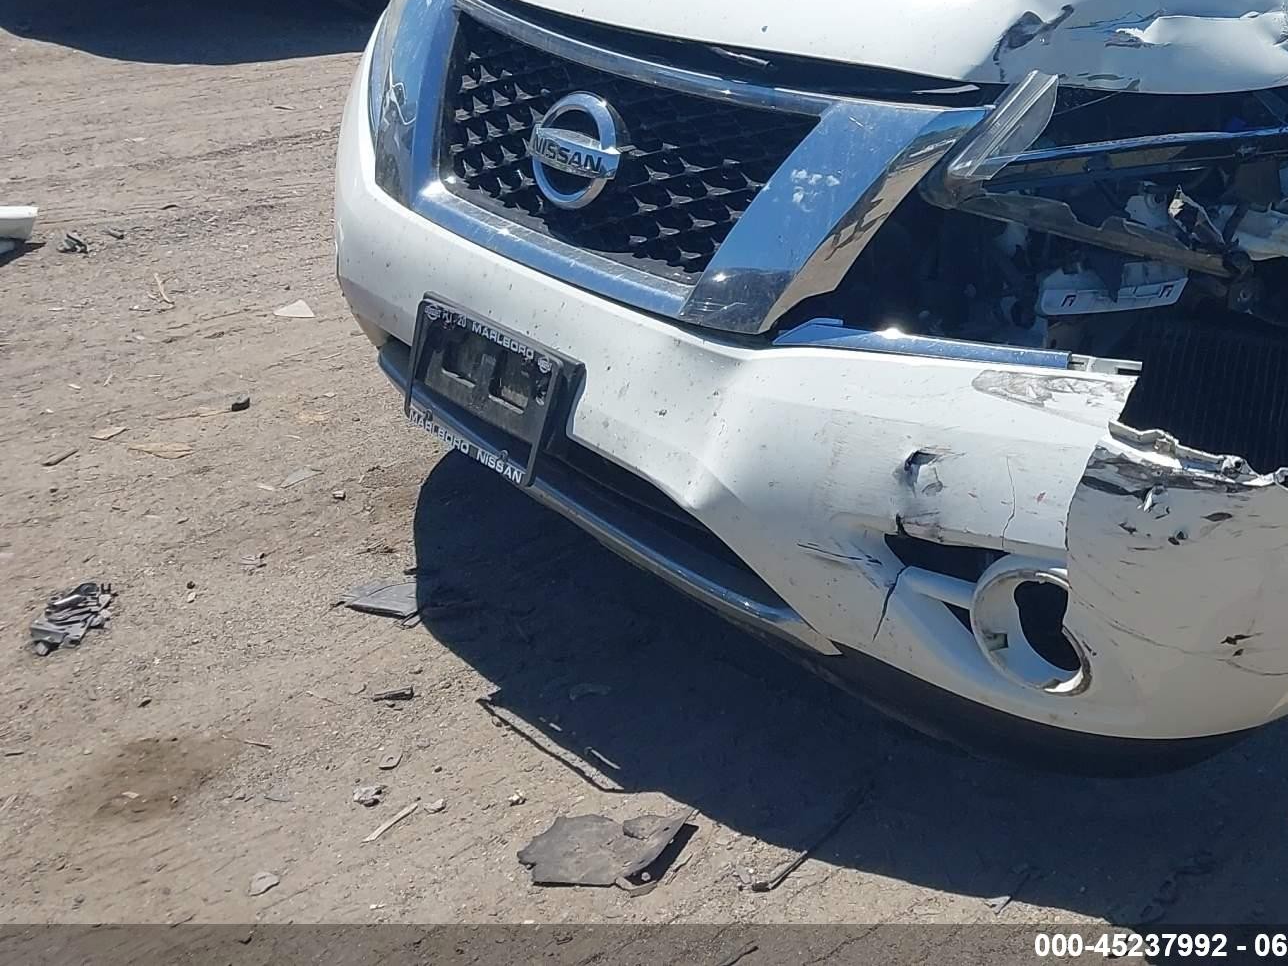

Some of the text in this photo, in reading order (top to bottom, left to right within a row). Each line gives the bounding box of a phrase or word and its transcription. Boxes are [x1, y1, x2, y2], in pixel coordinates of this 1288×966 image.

[534, 135, 602, 172] NISSAN
[472, 321, 535, 360] MARLBORO
[409, 409, 522, 484] MARLBORO NISSAN
